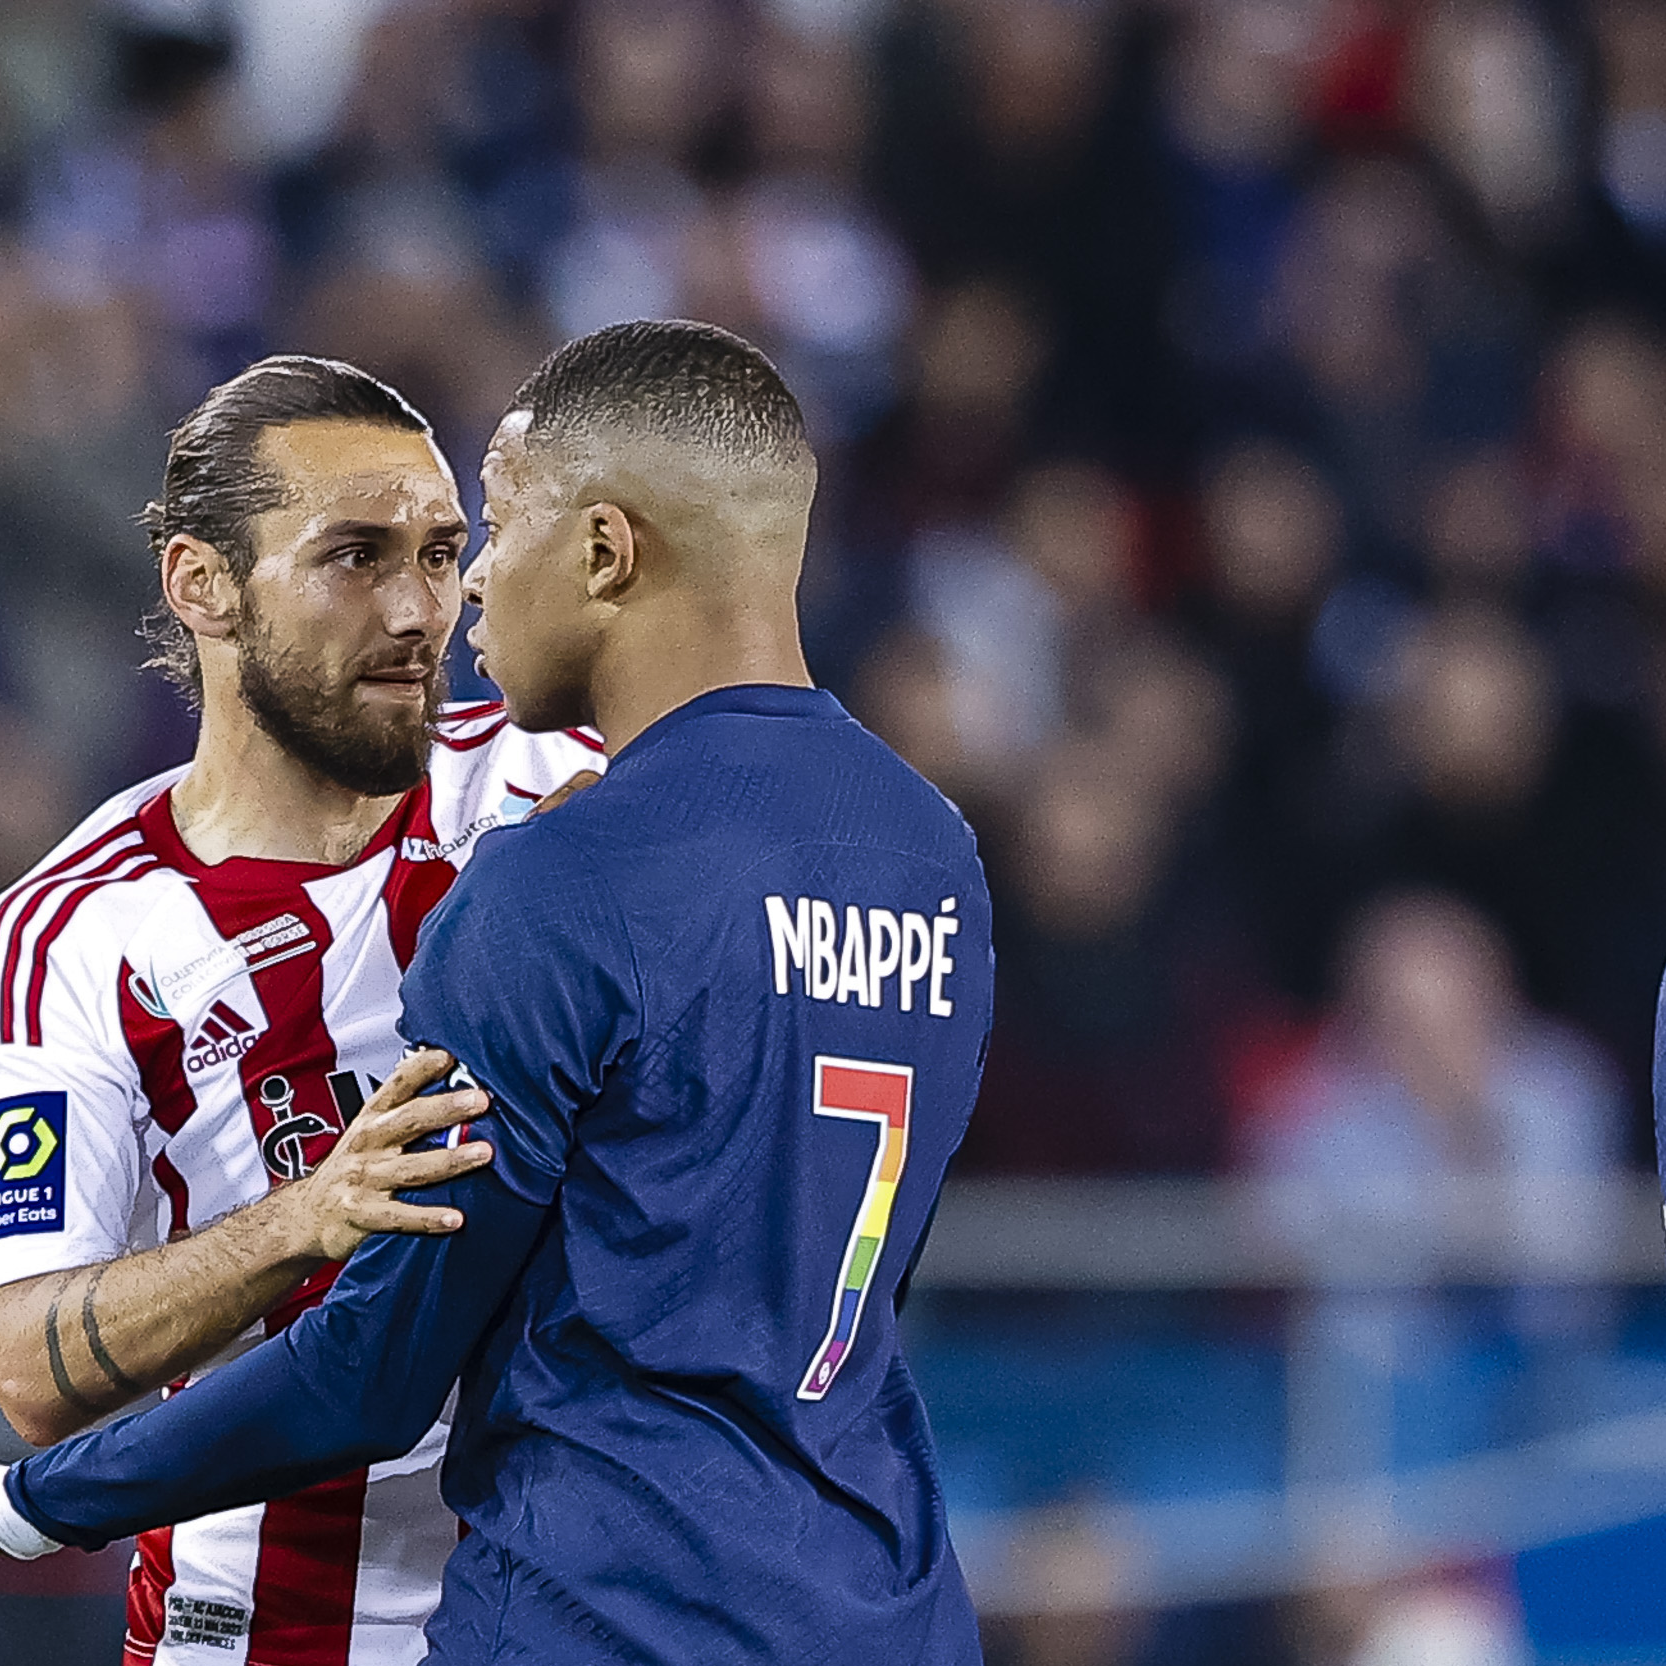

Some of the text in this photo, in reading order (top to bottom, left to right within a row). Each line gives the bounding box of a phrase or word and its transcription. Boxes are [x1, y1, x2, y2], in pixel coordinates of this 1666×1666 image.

[764, 896, 959, 1017] MBAPPÉ
[187, 1030, 267, 1073] adida
[18, 1207, 56, 1222] Eats
[44, 1187, 52, 1200] 1
[796, 1055, 914, 1401] 7
